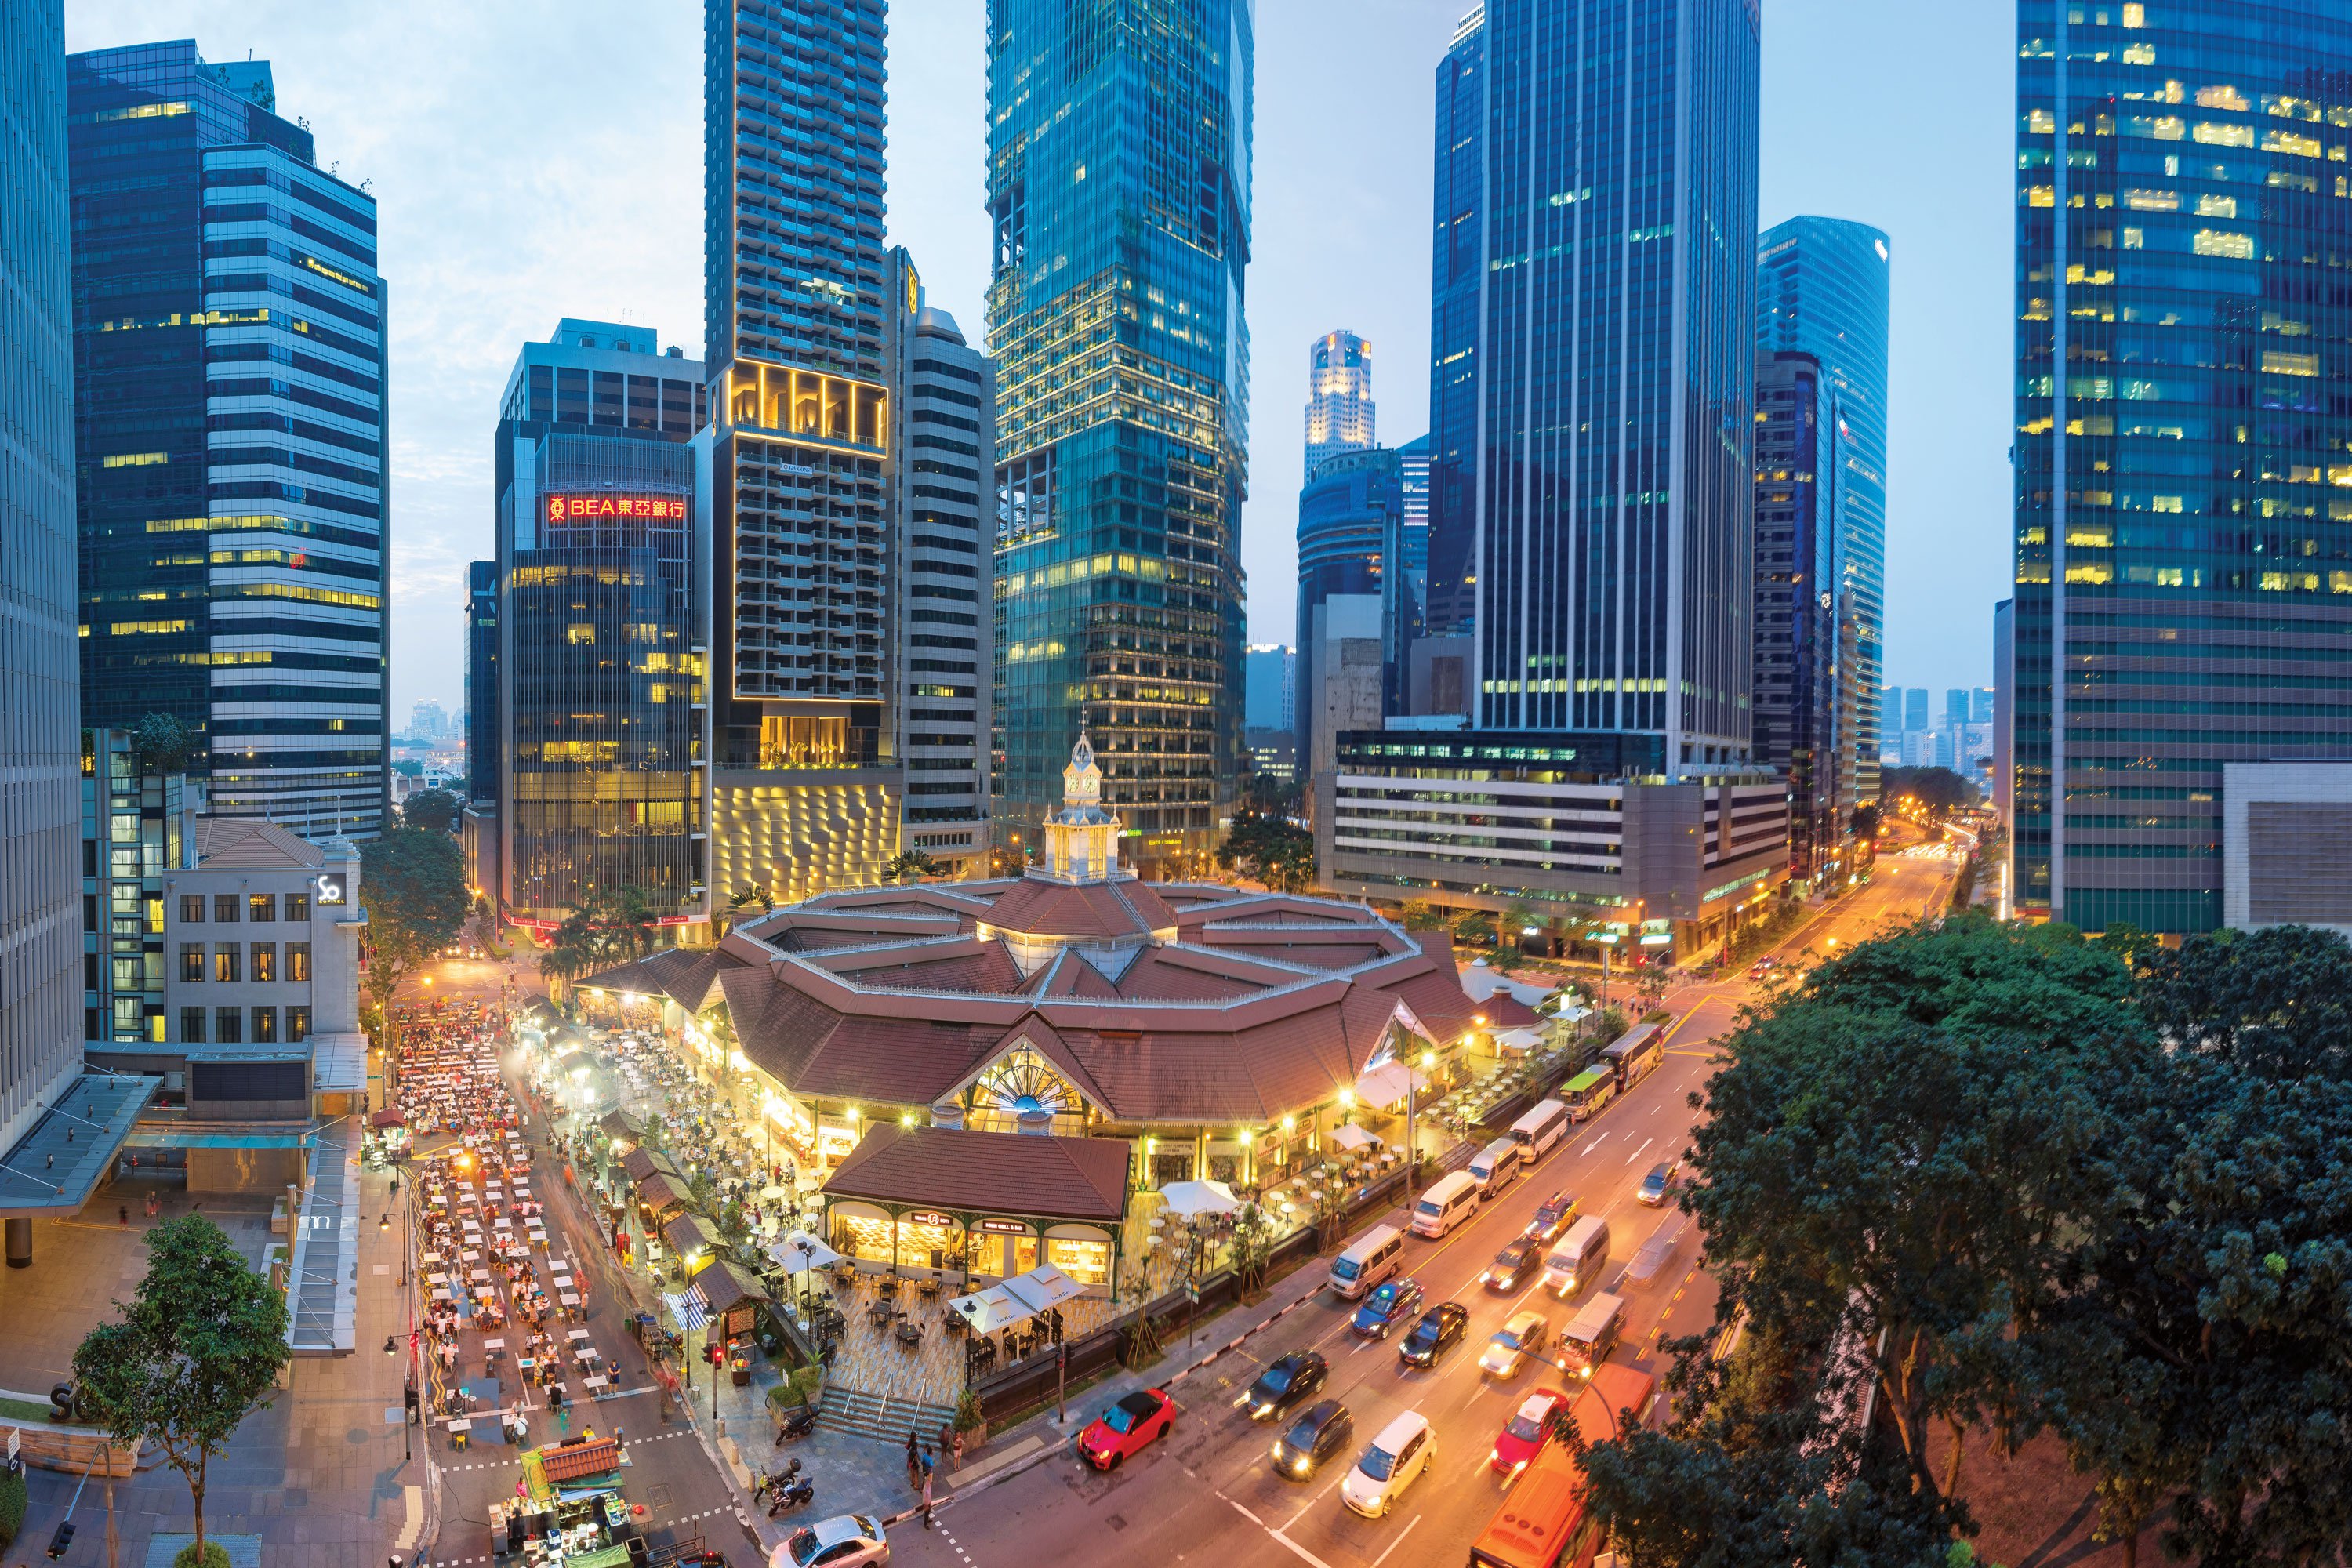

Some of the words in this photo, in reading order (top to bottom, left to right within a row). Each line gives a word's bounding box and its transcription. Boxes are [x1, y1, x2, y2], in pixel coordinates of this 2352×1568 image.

[570, 499, 615, 516] BEA
[618, 499, 684, 518] 東亞銀行
[318, 875, 340, 901] So
